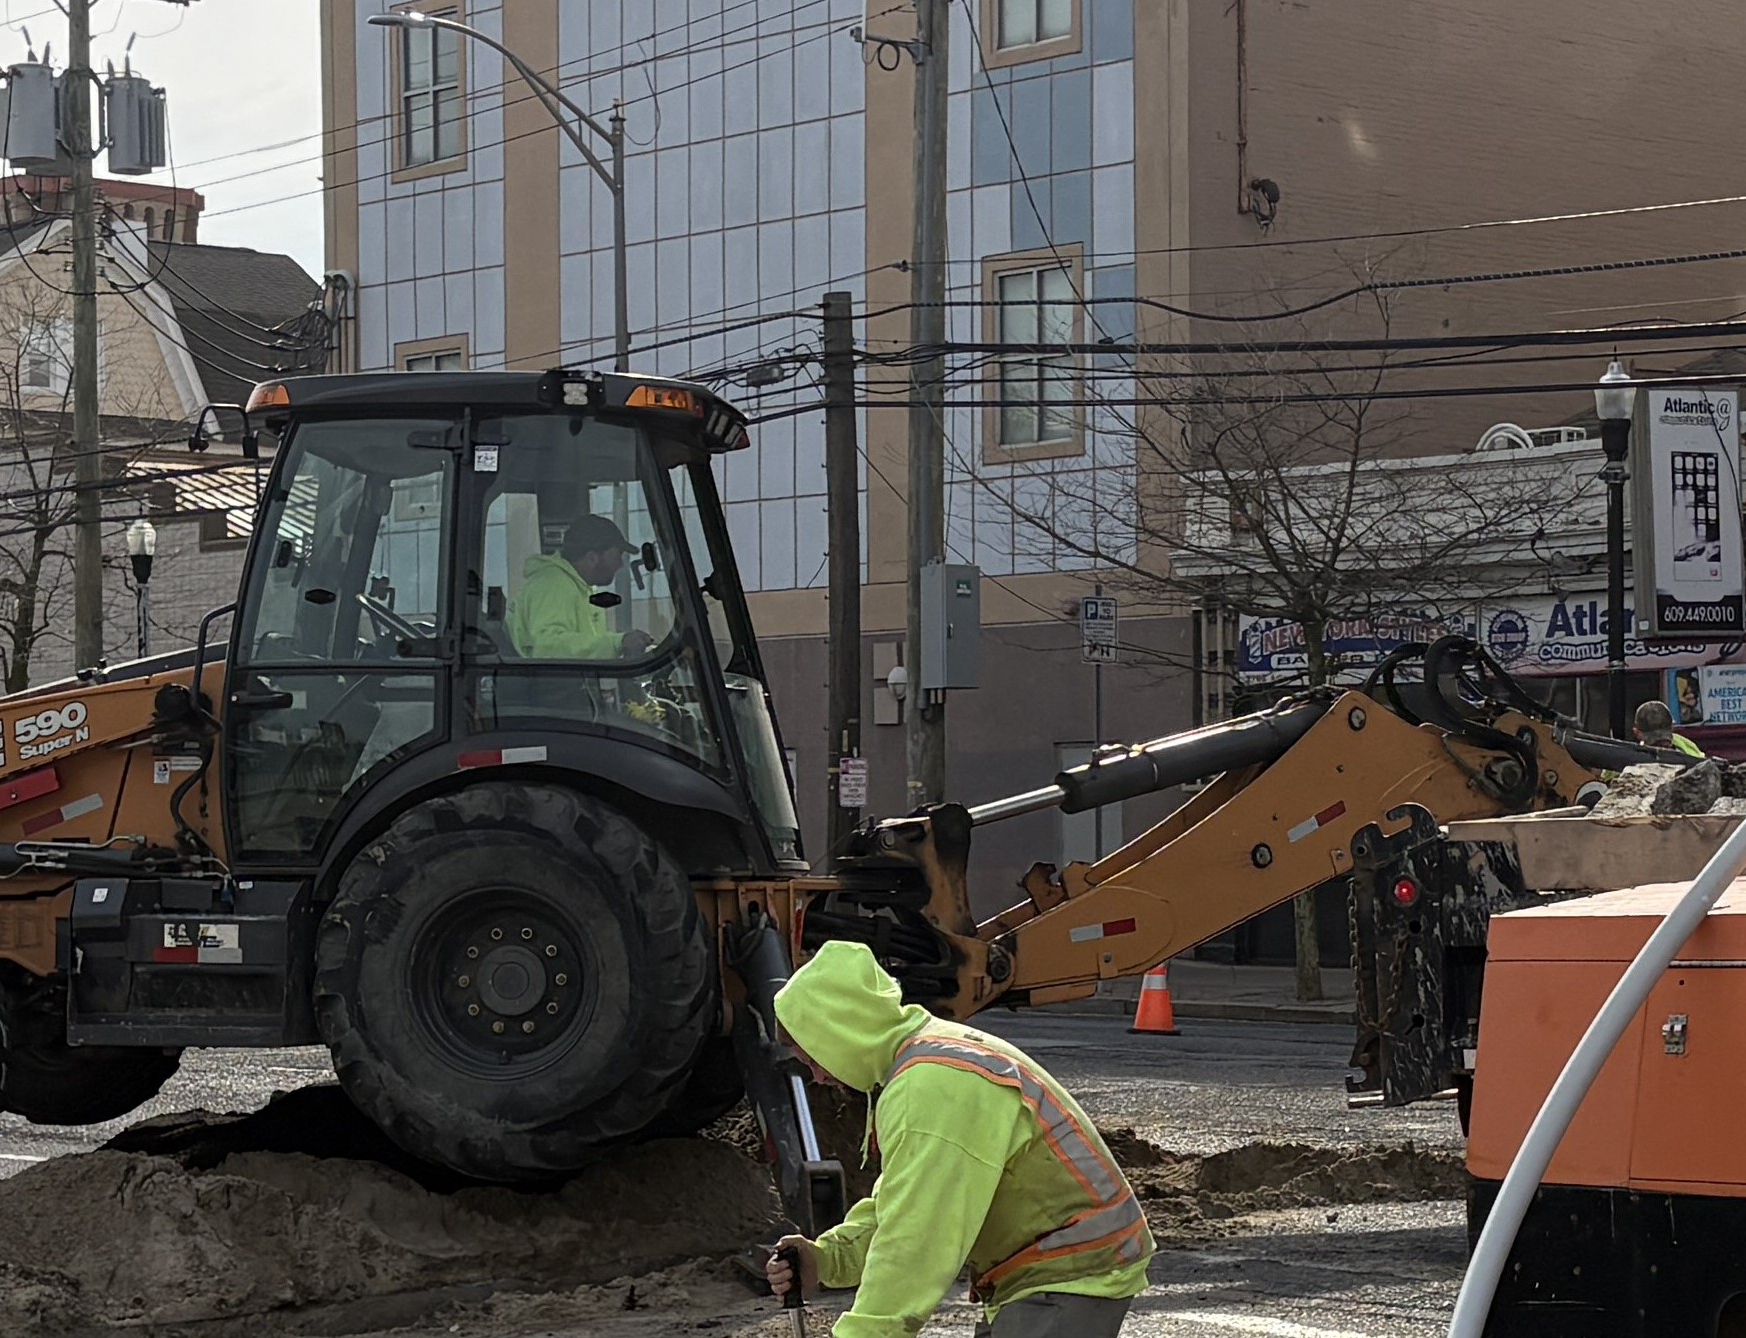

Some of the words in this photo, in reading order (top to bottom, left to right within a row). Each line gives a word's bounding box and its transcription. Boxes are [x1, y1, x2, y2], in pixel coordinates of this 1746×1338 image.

[1663, 397, 1715, 414] Atlantic
[1664, 606, 1735, 623] 609.449.0010
[1721, 698, 1742, 710] BEST
[15, 701, 88, 743] 590
[19, 733, 73, 760] Super
[75, 726, 90, 744] N
